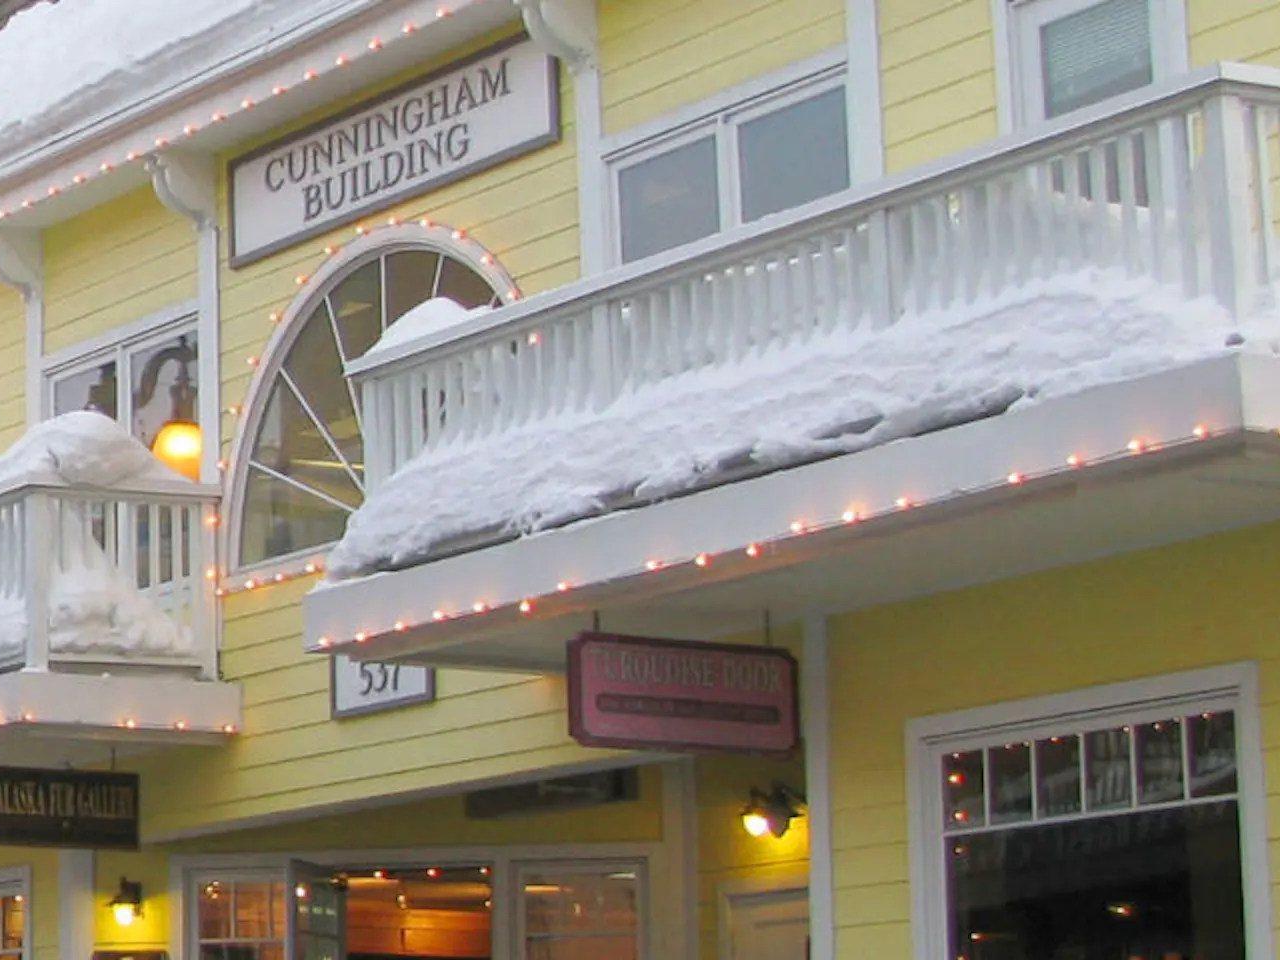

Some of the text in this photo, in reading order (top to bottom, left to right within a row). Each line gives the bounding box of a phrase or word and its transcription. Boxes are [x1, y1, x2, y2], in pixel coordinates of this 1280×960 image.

[264, 57, 511, 193] CUNNINGHAM
[301, 122, 471, 222] BUILDING
[722, 657, 783, 693] DOOR
[48, 781, 75, 817] FUR
[77, 783, 135, 818] GALLERY
